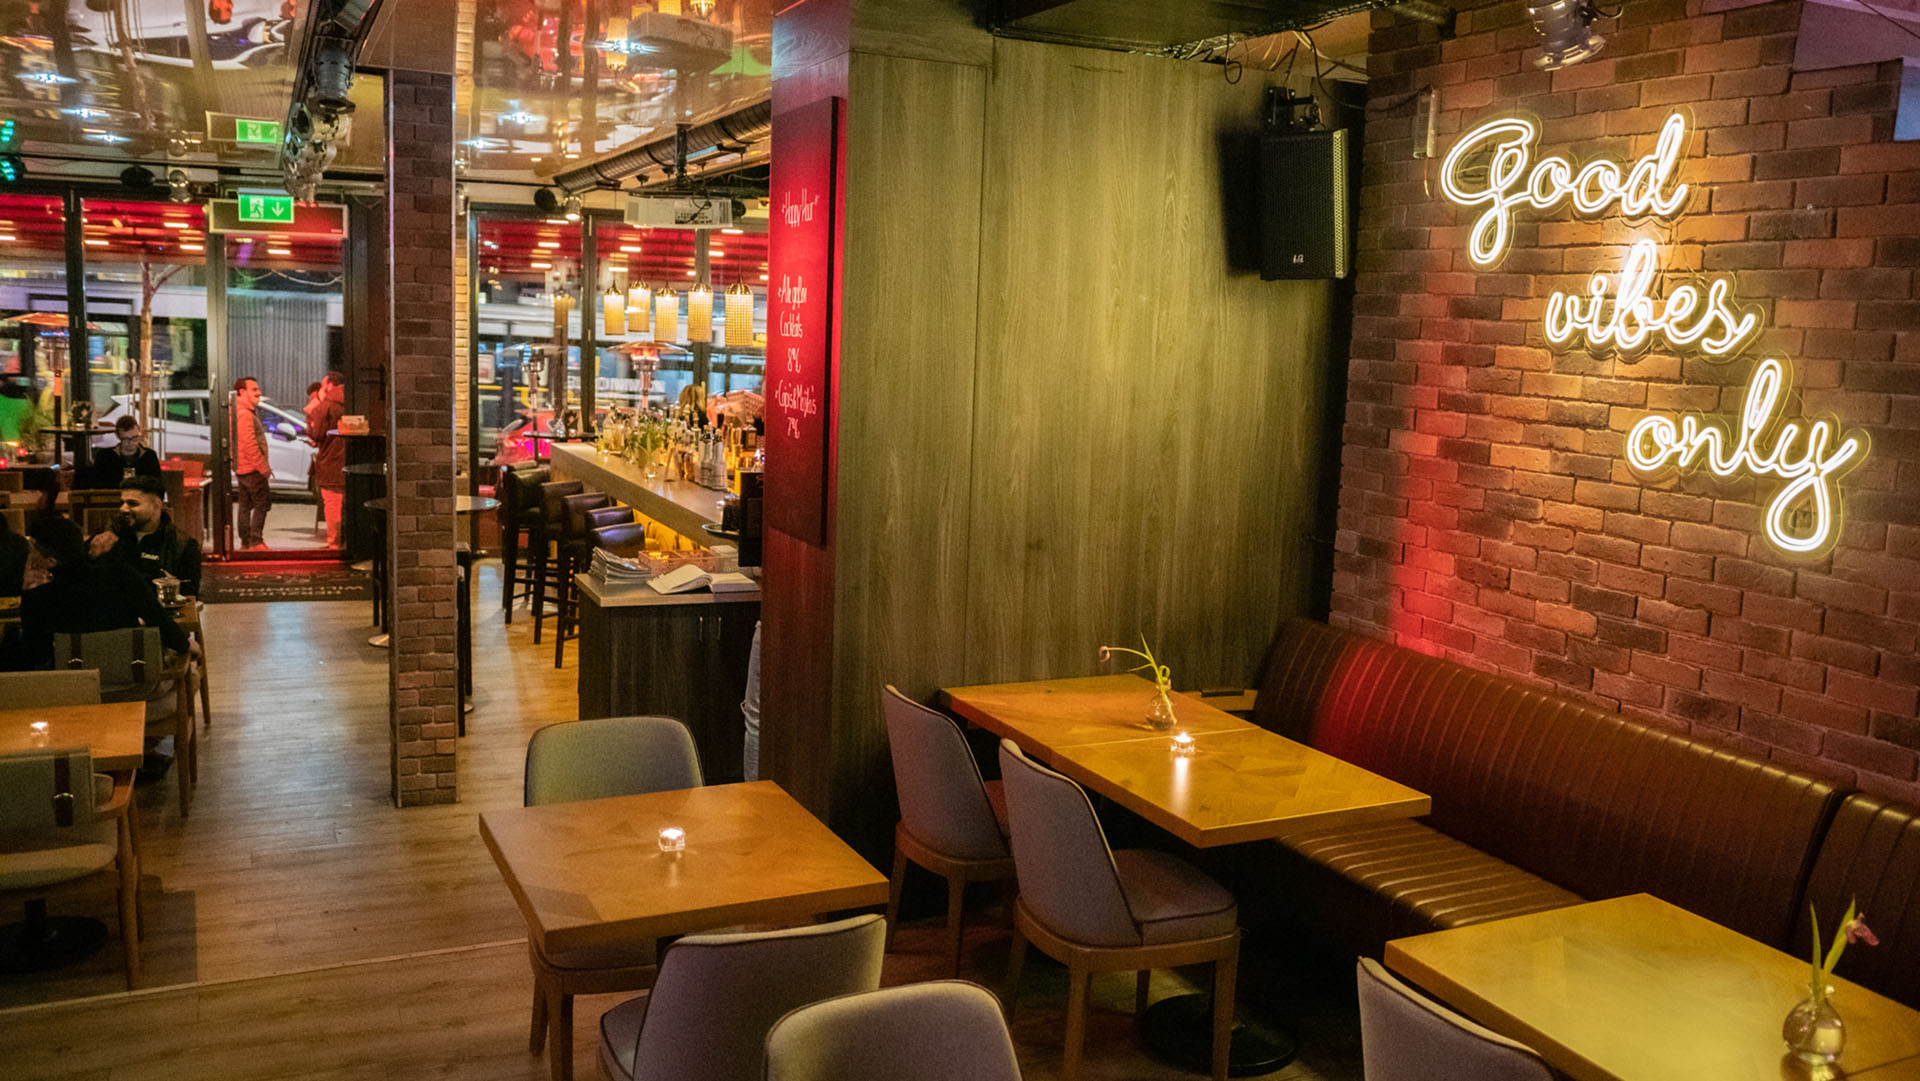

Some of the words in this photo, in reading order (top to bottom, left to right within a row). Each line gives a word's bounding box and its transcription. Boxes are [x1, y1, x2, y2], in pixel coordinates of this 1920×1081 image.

[1440, 113, 1689, 264] Good
[1545, 238, 1755, 354] vibes
[1627, 359, 1858, 552] only
